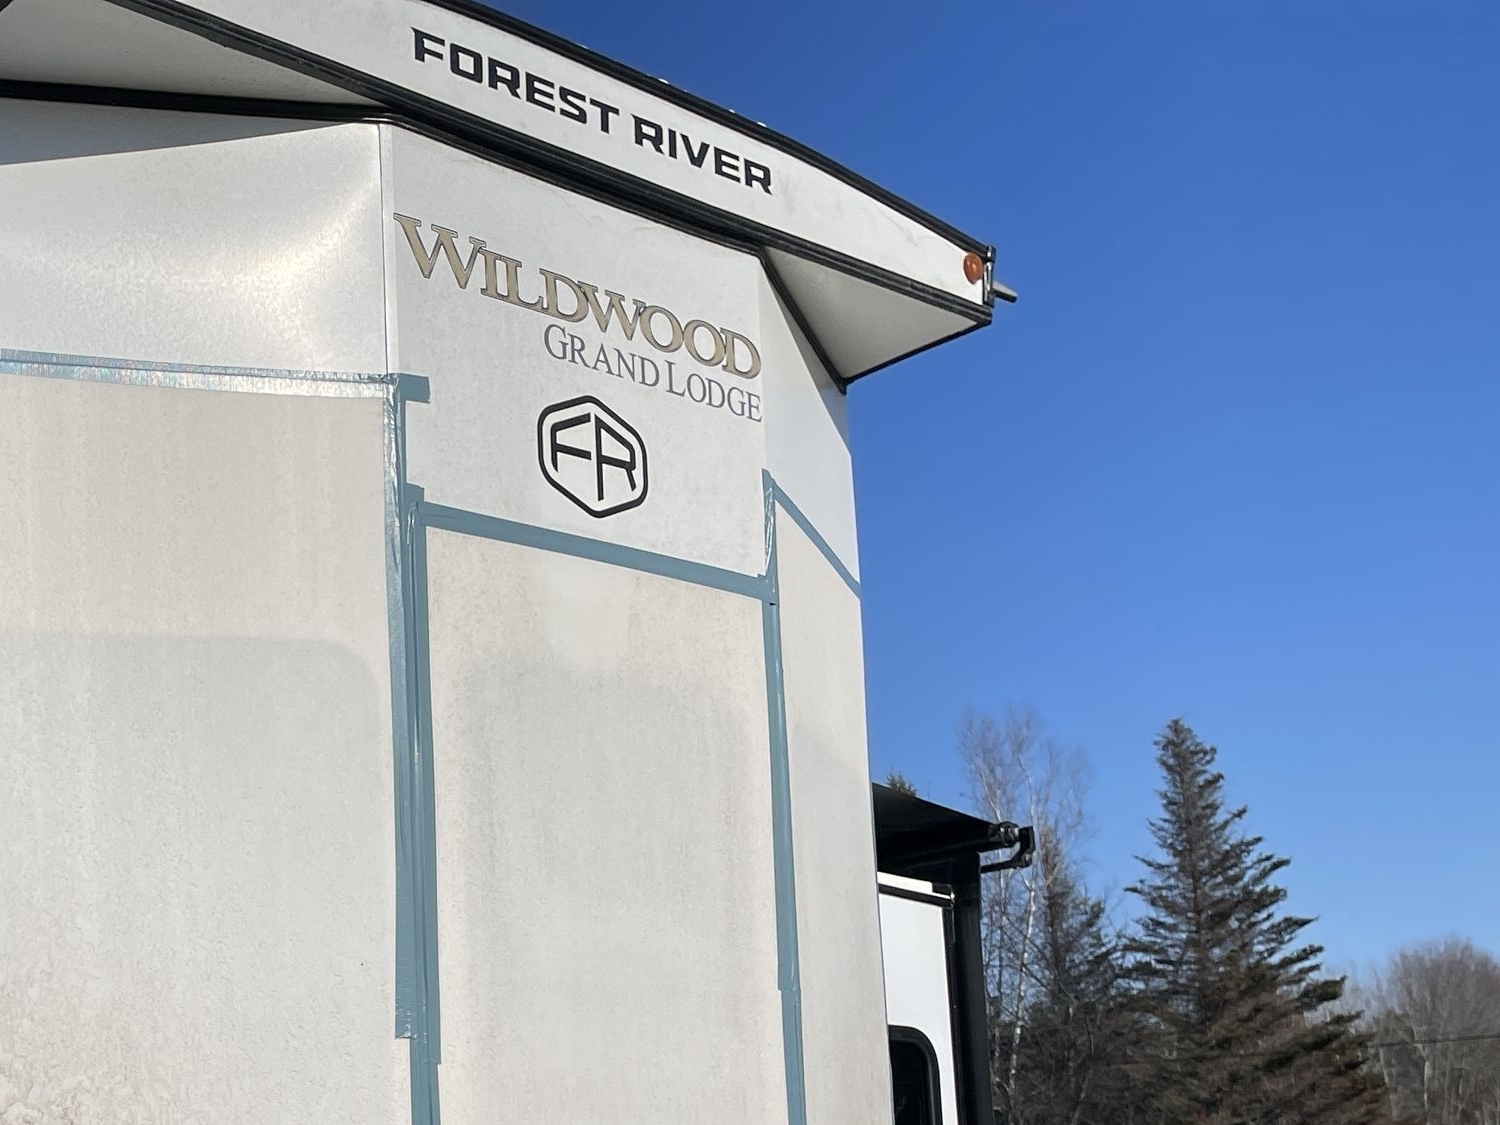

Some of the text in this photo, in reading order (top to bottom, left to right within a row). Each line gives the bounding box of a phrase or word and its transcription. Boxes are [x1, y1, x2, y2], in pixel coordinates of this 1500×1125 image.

[411, 26, 773, 195] FOREST RIVER
[394, 212, 762, 380] WILDWOOD
[544, 322, 762, 424] GRAND LODGE
